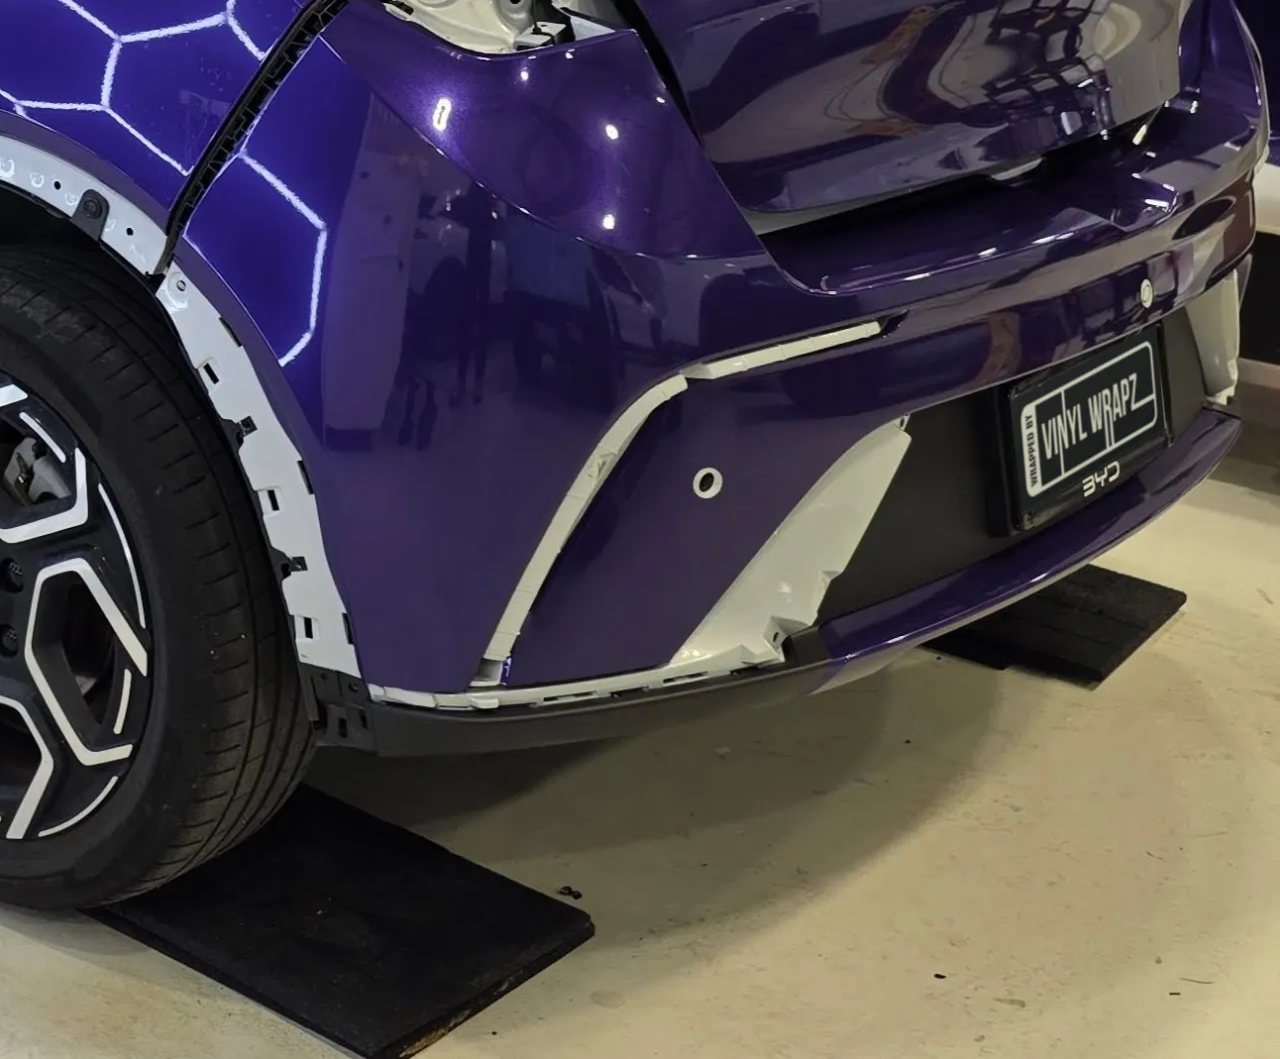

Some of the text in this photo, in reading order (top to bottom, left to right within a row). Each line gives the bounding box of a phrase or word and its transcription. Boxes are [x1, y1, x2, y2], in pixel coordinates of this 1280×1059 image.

[1024, 414, 1039, 488] WRAPPED BY
[1041, 373, 1138, 459] VINYL WRAPZ
[1082, 460, 1120, 497] BYD
